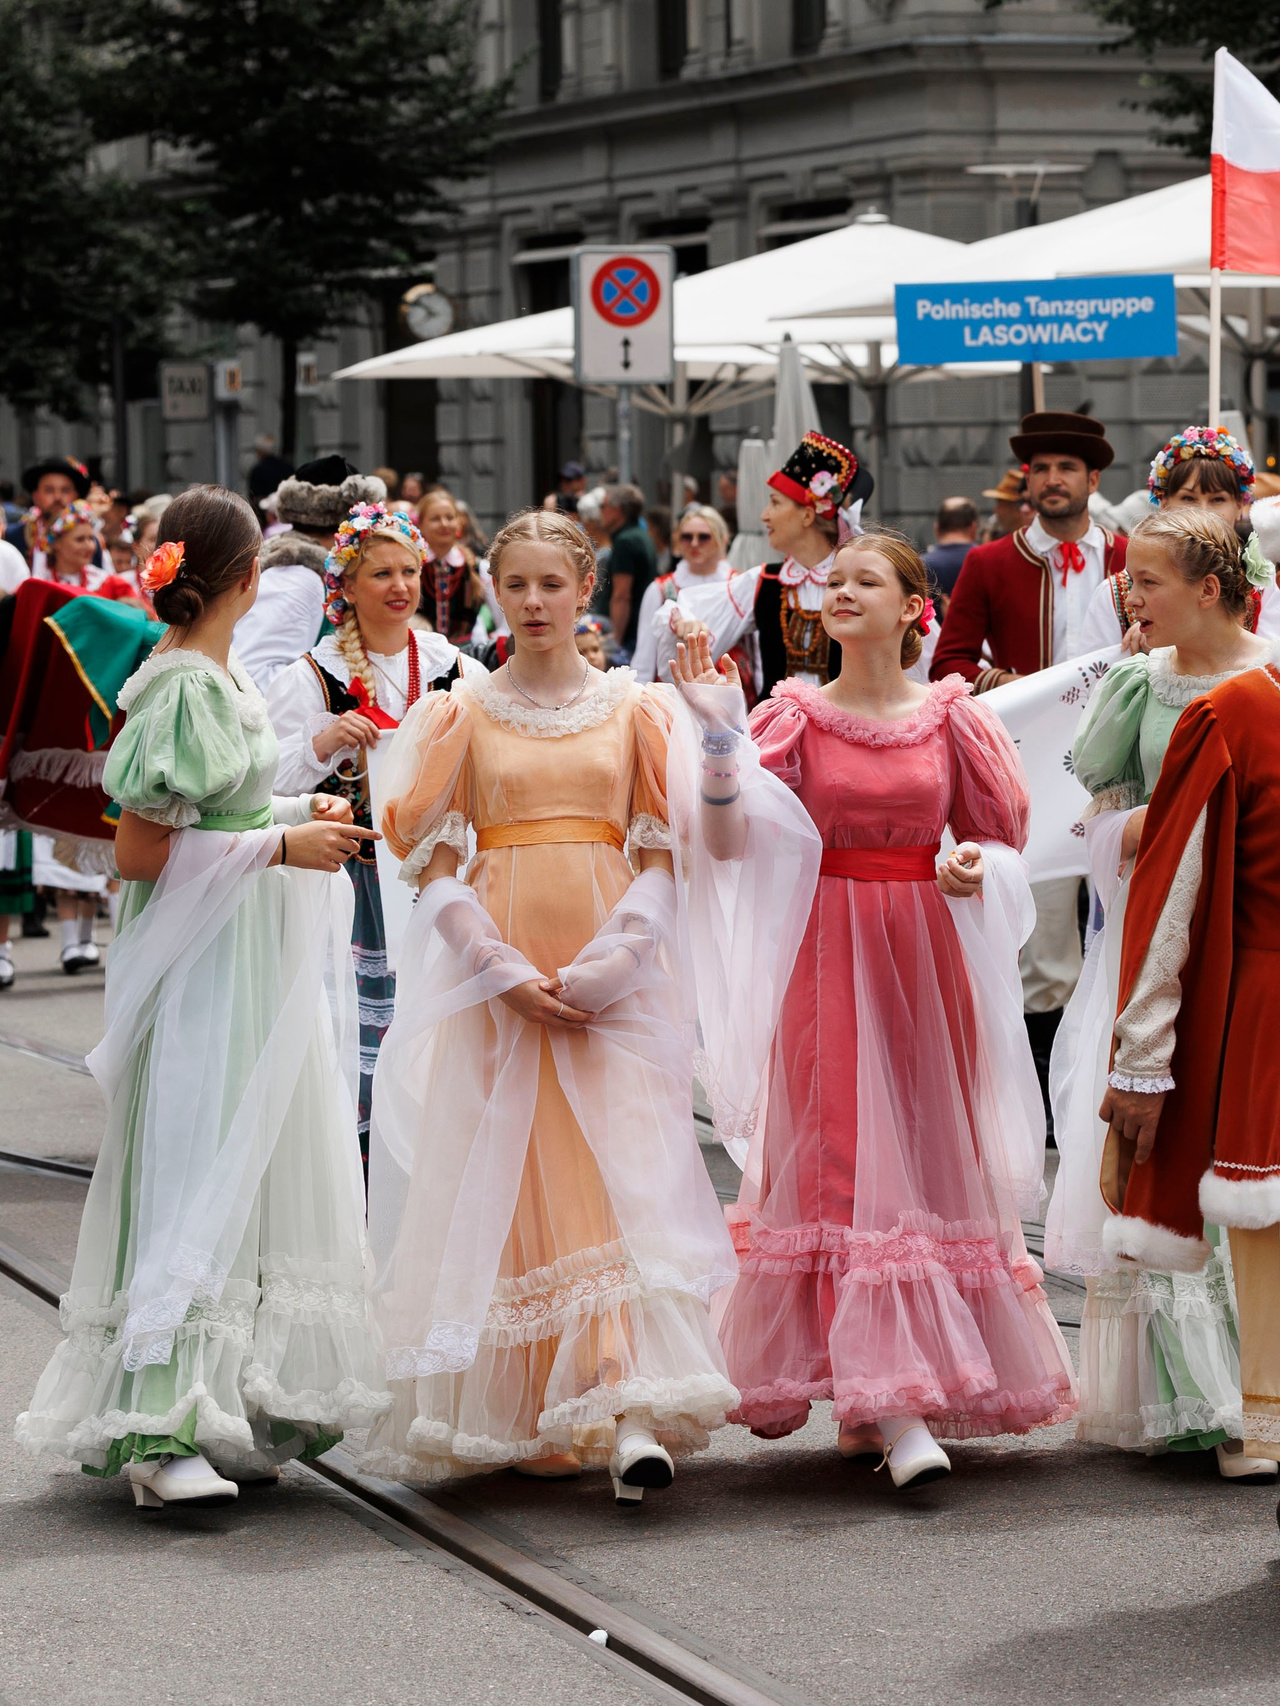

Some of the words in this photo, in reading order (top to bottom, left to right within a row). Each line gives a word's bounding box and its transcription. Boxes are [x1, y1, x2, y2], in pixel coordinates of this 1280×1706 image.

[916, 298, 1021, 321] Polnische
[1024, 296, 1155, 320] Tanzgruppe
[964, 321, 1109, 347] LASOWIACY
